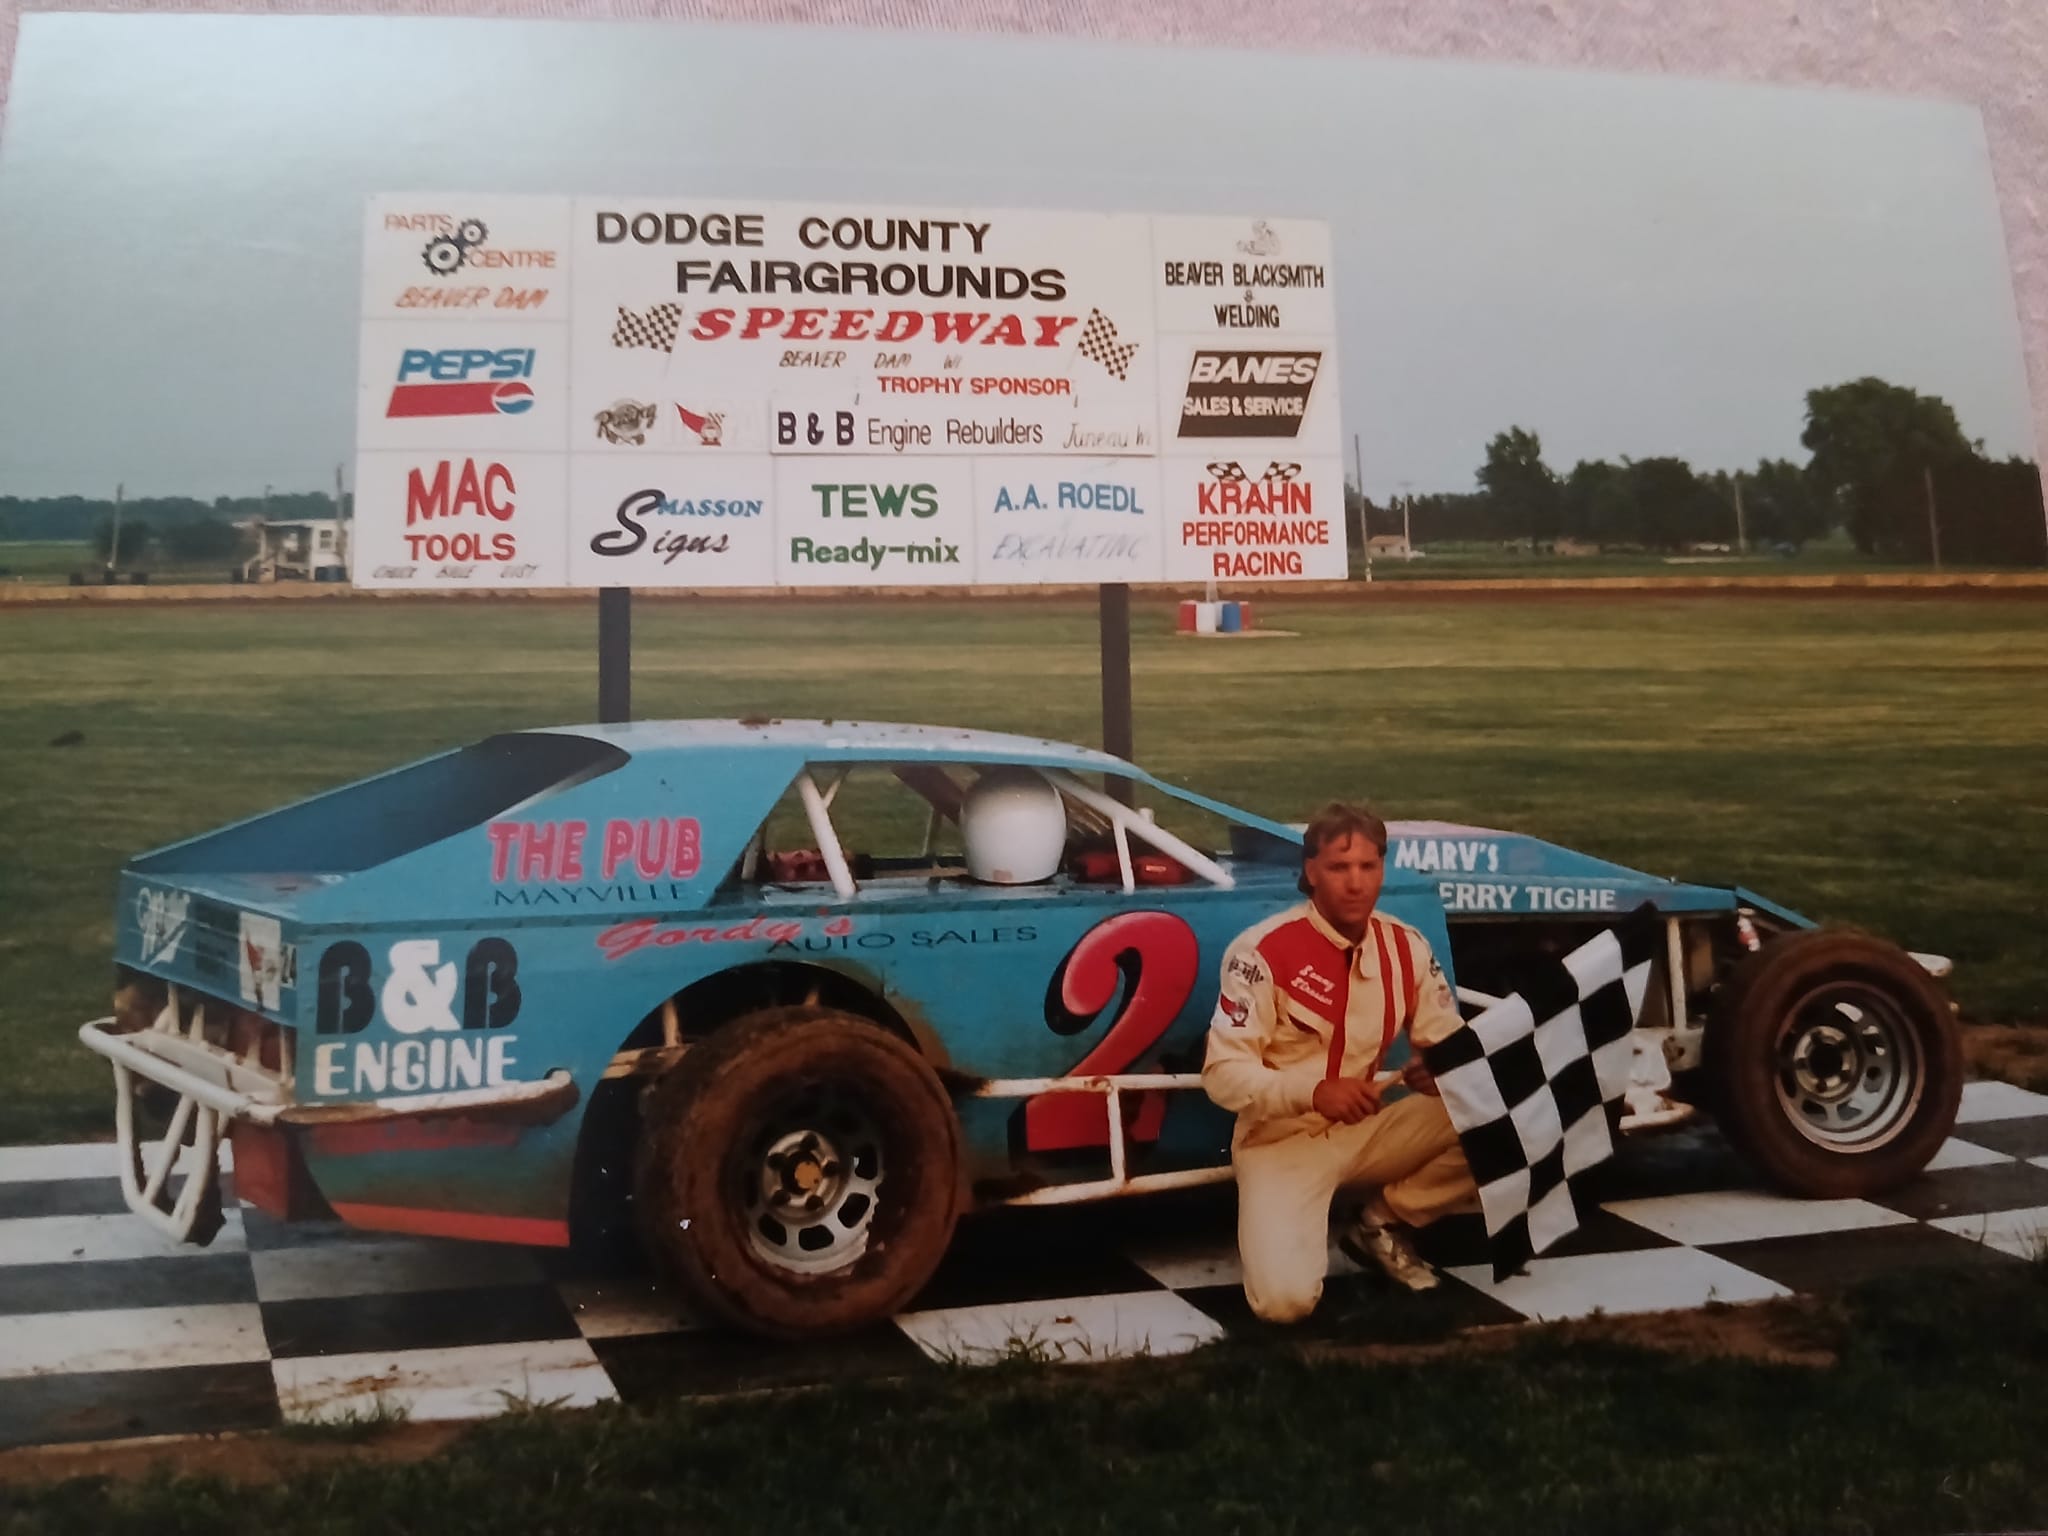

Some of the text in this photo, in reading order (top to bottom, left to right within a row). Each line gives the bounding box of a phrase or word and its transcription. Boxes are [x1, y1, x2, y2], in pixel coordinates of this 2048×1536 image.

[384, 214, 453, 232] PARTS
[597, 212, 991, 254] DODGE COUNTY
[468, 249, 557, 269] CENTRE
[1165, 261, 1325, 288] BEAVER BLACKSMITH
[677, 260, 1067, 301] FAIRGROUNDS
[690, 307, 1079, 348] SPEEDWAY
[1214, 304, 1281, 328] WELDING
[397, 349, 536, 381] PEPSI
[779, 350, 847, 369] BEAVER
[874, 351, 912, 369] DAM
[1190, 356, 1318, 384] BANES
[877, 376, 1071, 396] TROPHY SPONSOR
[1184, 396, 1304, 417] SALES & SERVICE
[777, 411, 797, 445] B
[807, 412, 824, 445] &
[836, 411, 855, 446] B
[868, 418, 932, 452] Engine
[946, 419, 1043, 446] Rebuilders
[406, 458, 517, 527] MAC
[656, 499, 763, 518] MASSON
[811, 484, 939, 518] TEWS
[994, 482, 1144, 515] A.A. ROEDL
[1197, 483, 1312, 516] KRAHN
[590, 489, 730, 565] Signs
[1182, 521, 1328, 546] PERFORMANCE
[404, 533, 516, 561] TOOLS
[791, 537, 960, 571] Ready-mix
[1213, 550, 1302, 578] RACING
[487, 816, 702, 884] THE PUB
[1394, 839, 1499, 872] MARV'S
[1438, 882, 1616, 911] ERRY TIGHE
[596, 907, 853, 960] Gordy's
[767, 926, 1037, 953] AUTO SALES
[316, 937, 522, 1035] B&B
[1012, 910, 1199, 1157] 2
[313, 1036, 518, 1096] ENGINE
